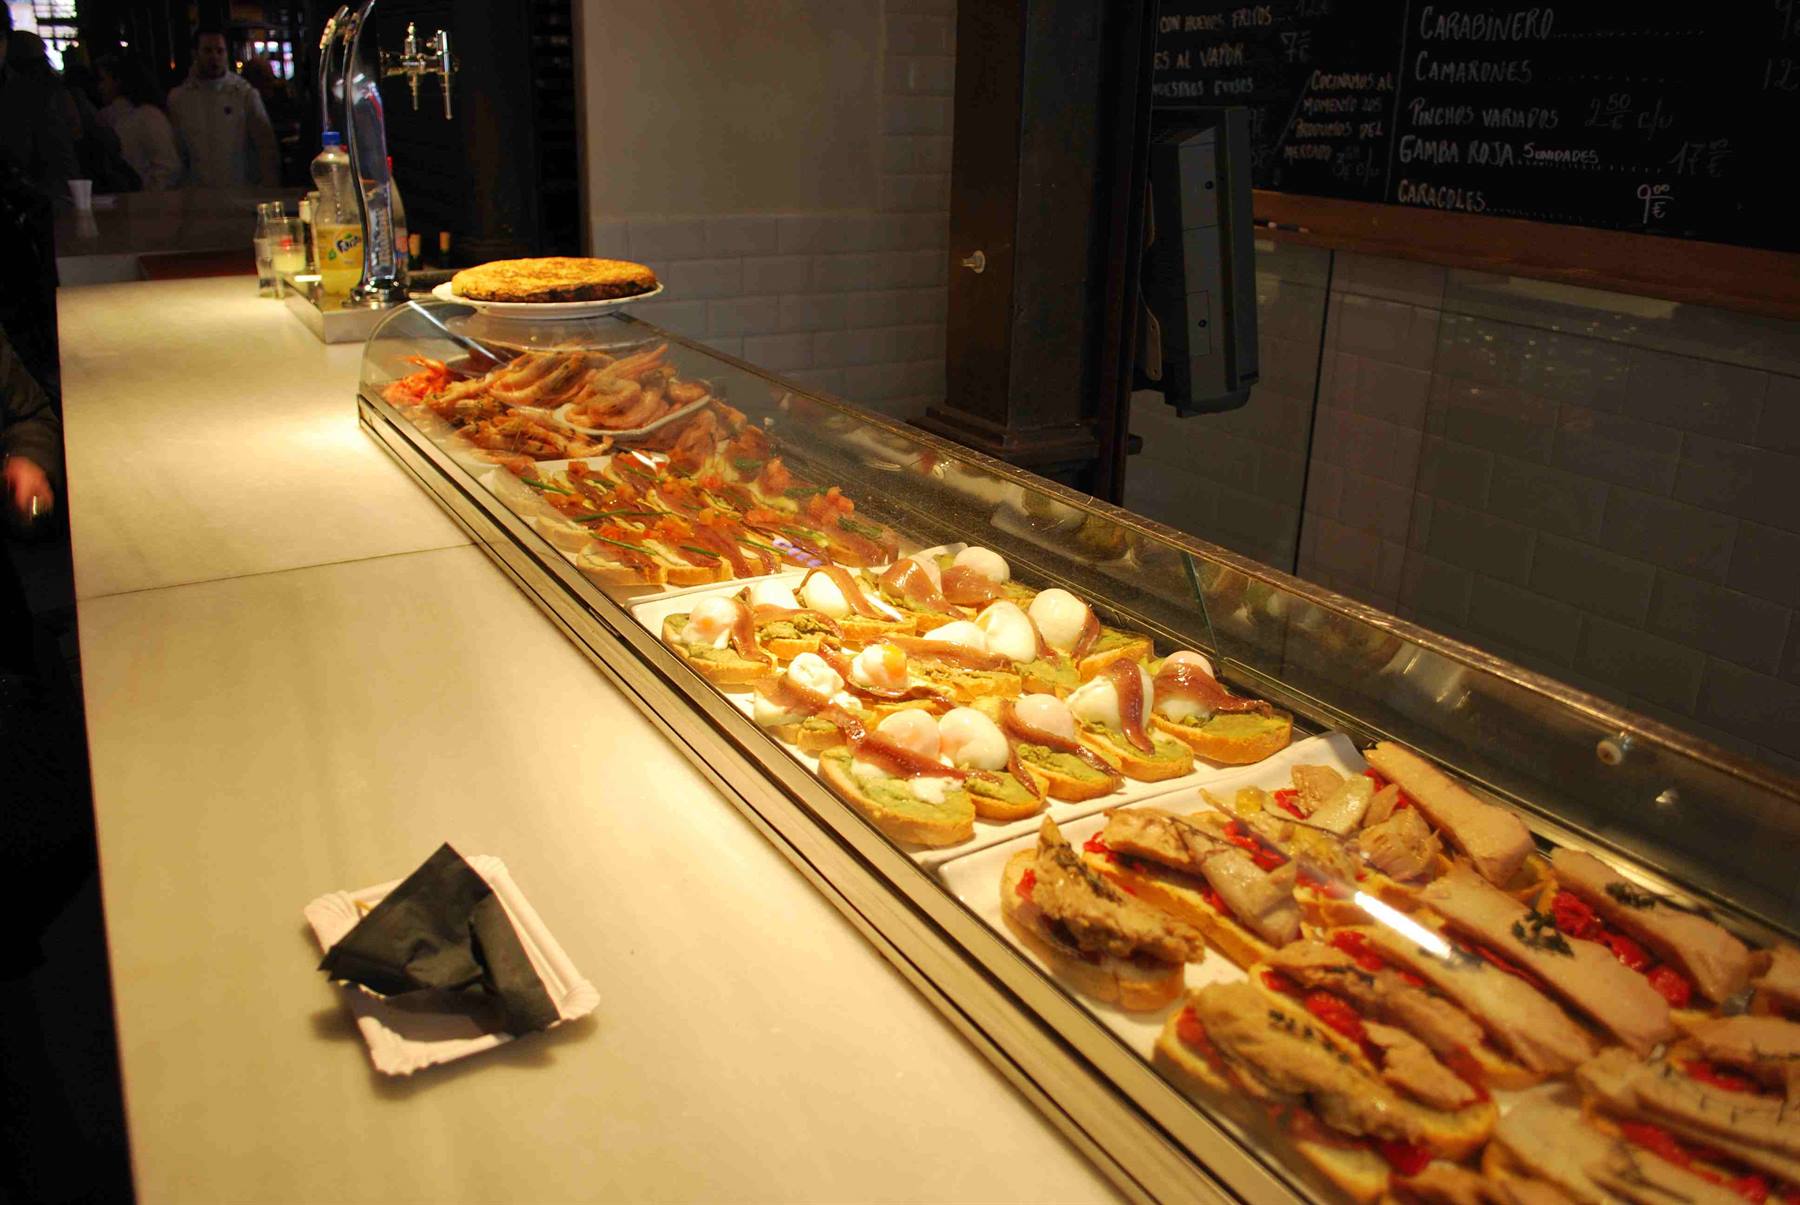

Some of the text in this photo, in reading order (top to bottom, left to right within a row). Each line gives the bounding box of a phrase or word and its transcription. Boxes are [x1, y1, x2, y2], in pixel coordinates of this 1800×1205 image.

[1420, 5, 1554, 41] CARABINERO
[1415, 50, 1532, 84] CAMARONES
[1408, 97, 1475, 127] PINCHOS
[1480, 105, 1560, 130] VARIADOS
[1399, 134, 1460, 165] GAMBA
[1466, 139, 1514, 168] ROJA
[1398, 178, 1487, 213] CARACOLES
